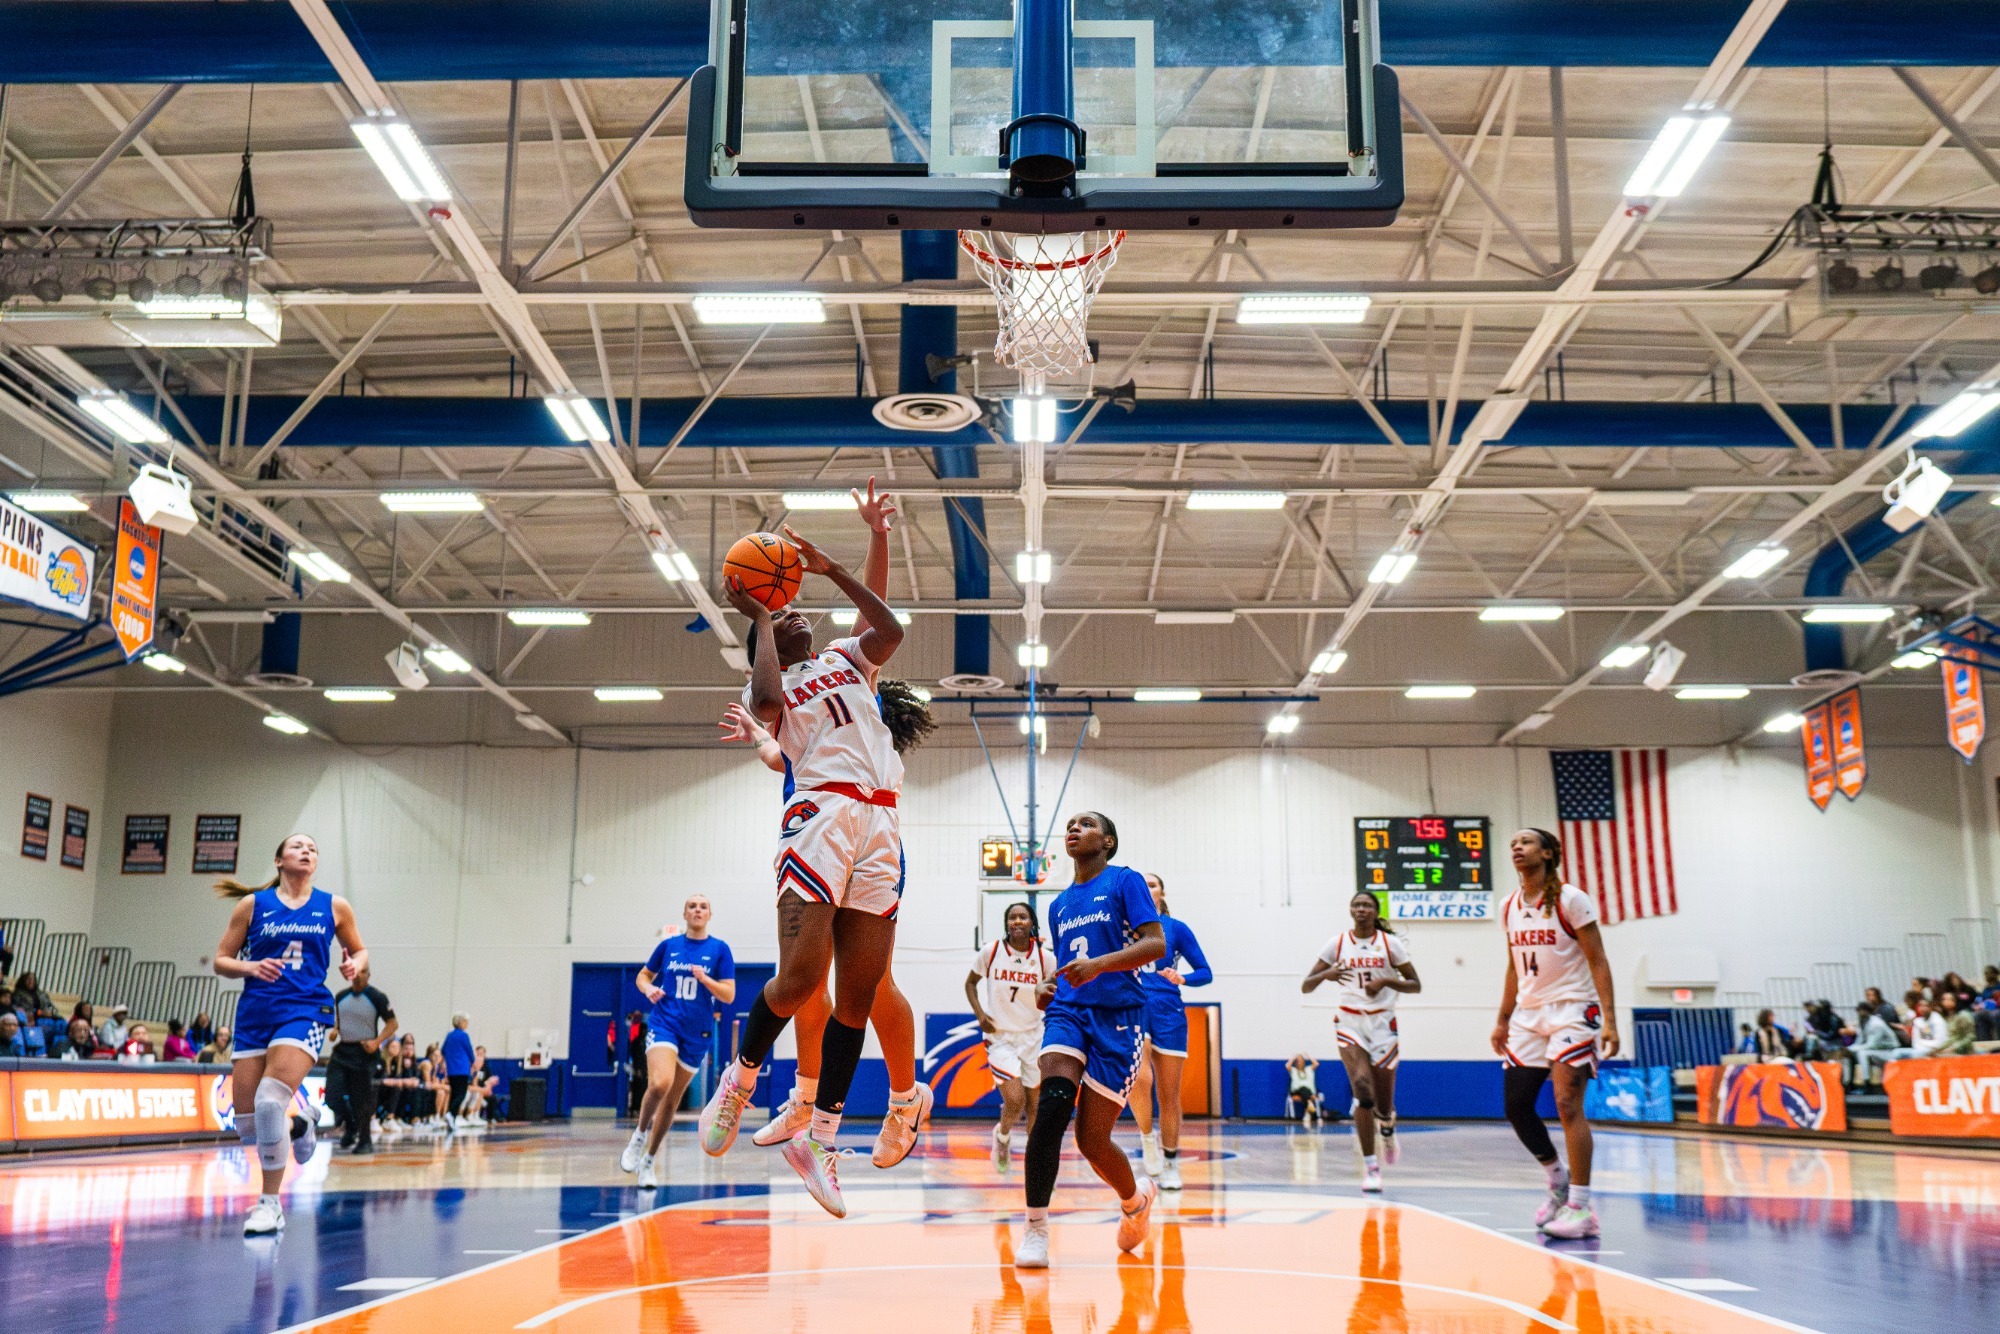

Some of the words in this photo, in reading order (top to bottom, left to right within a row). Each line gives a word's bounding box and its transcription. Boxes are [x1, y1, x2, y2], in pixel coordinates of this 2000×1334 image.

[0, 541, 39, 582] TBALL
[782, 669, 861, 710] LAKERS
[822, 692, 854, 729] 11
[1365, 830, 1389, 850] 67
[1428, 842, 1440, 858] 4
[983, 843, 1012, 867] 27
[1413, 868, 1425, 883] 3
[1431, 868, 1443, 884] 2
[1471, 868, 1479, 883] 1
[1391, 892, 1433, 902] HOME
[1440, 892, 1457, 902] OF
[1464, 892, 1489, 902] THE
[1398, 904, 1487, 918] LAKERS
[260, 921, 326, 938] Nighthawks
[281, 940, 304, 971] 4
[1522, 951, 1538, 976] 14
[994, 968, 1037, 985] LAKERS
[675, 975, 698, 1000] 10
[1010, 986, 1019, 1002] 7
[24, 1088, 135, 1122] CLAYTON
[138, 1088, 198, 1118] STATE
